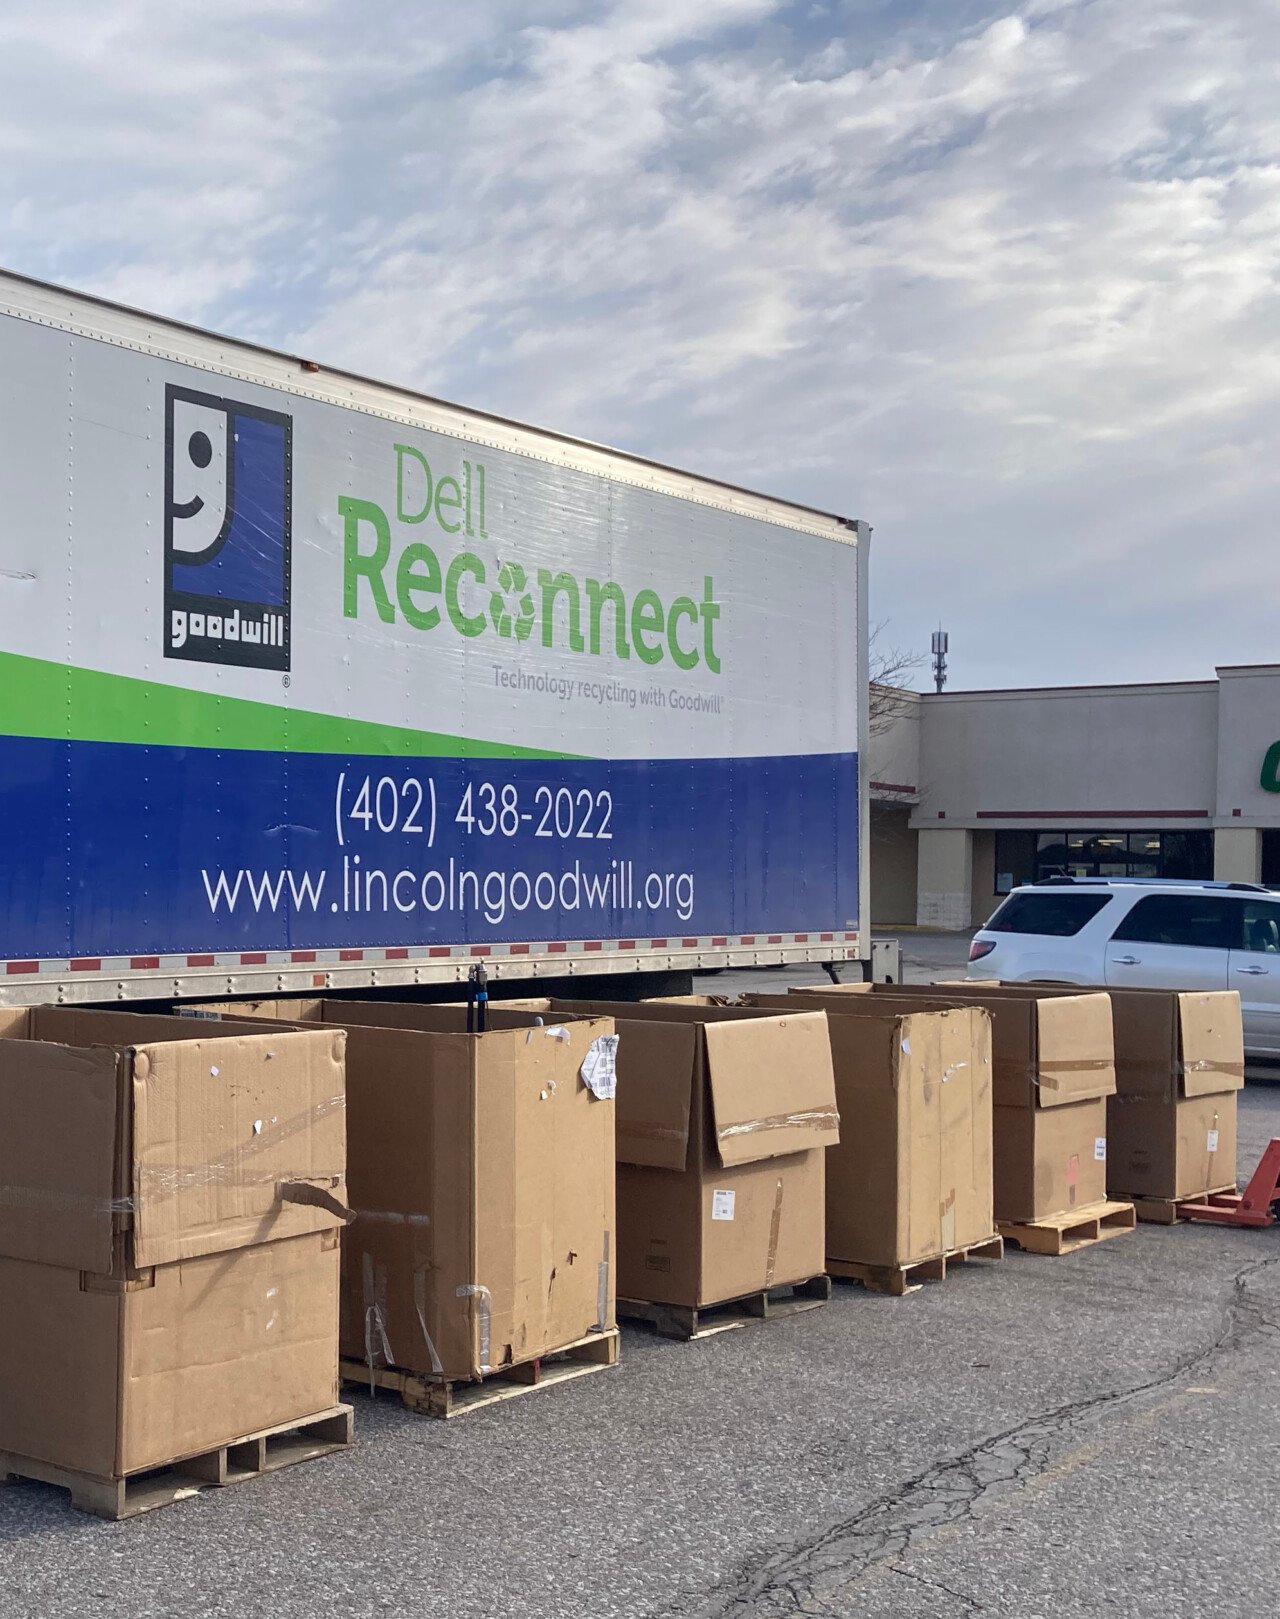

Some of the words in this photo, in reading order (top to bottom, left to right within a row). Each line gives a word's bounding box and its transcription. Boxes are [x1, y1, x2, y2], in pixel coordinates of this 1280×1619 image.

[393, 444, 488, 537] Dell
[171, 608, 284, 649] goodwill
[492, 664, 574, 701] Technology
[577, 680, 637, 709] recycling
[640, 686, 666, 708] with
[669, 688, 721, 715] Goodwill
[335, 772, 436, 846] (402)
[455, 782, 613, 839] 438-2022
[201, 855, 695, 925] www.lincolngoodwill.org
